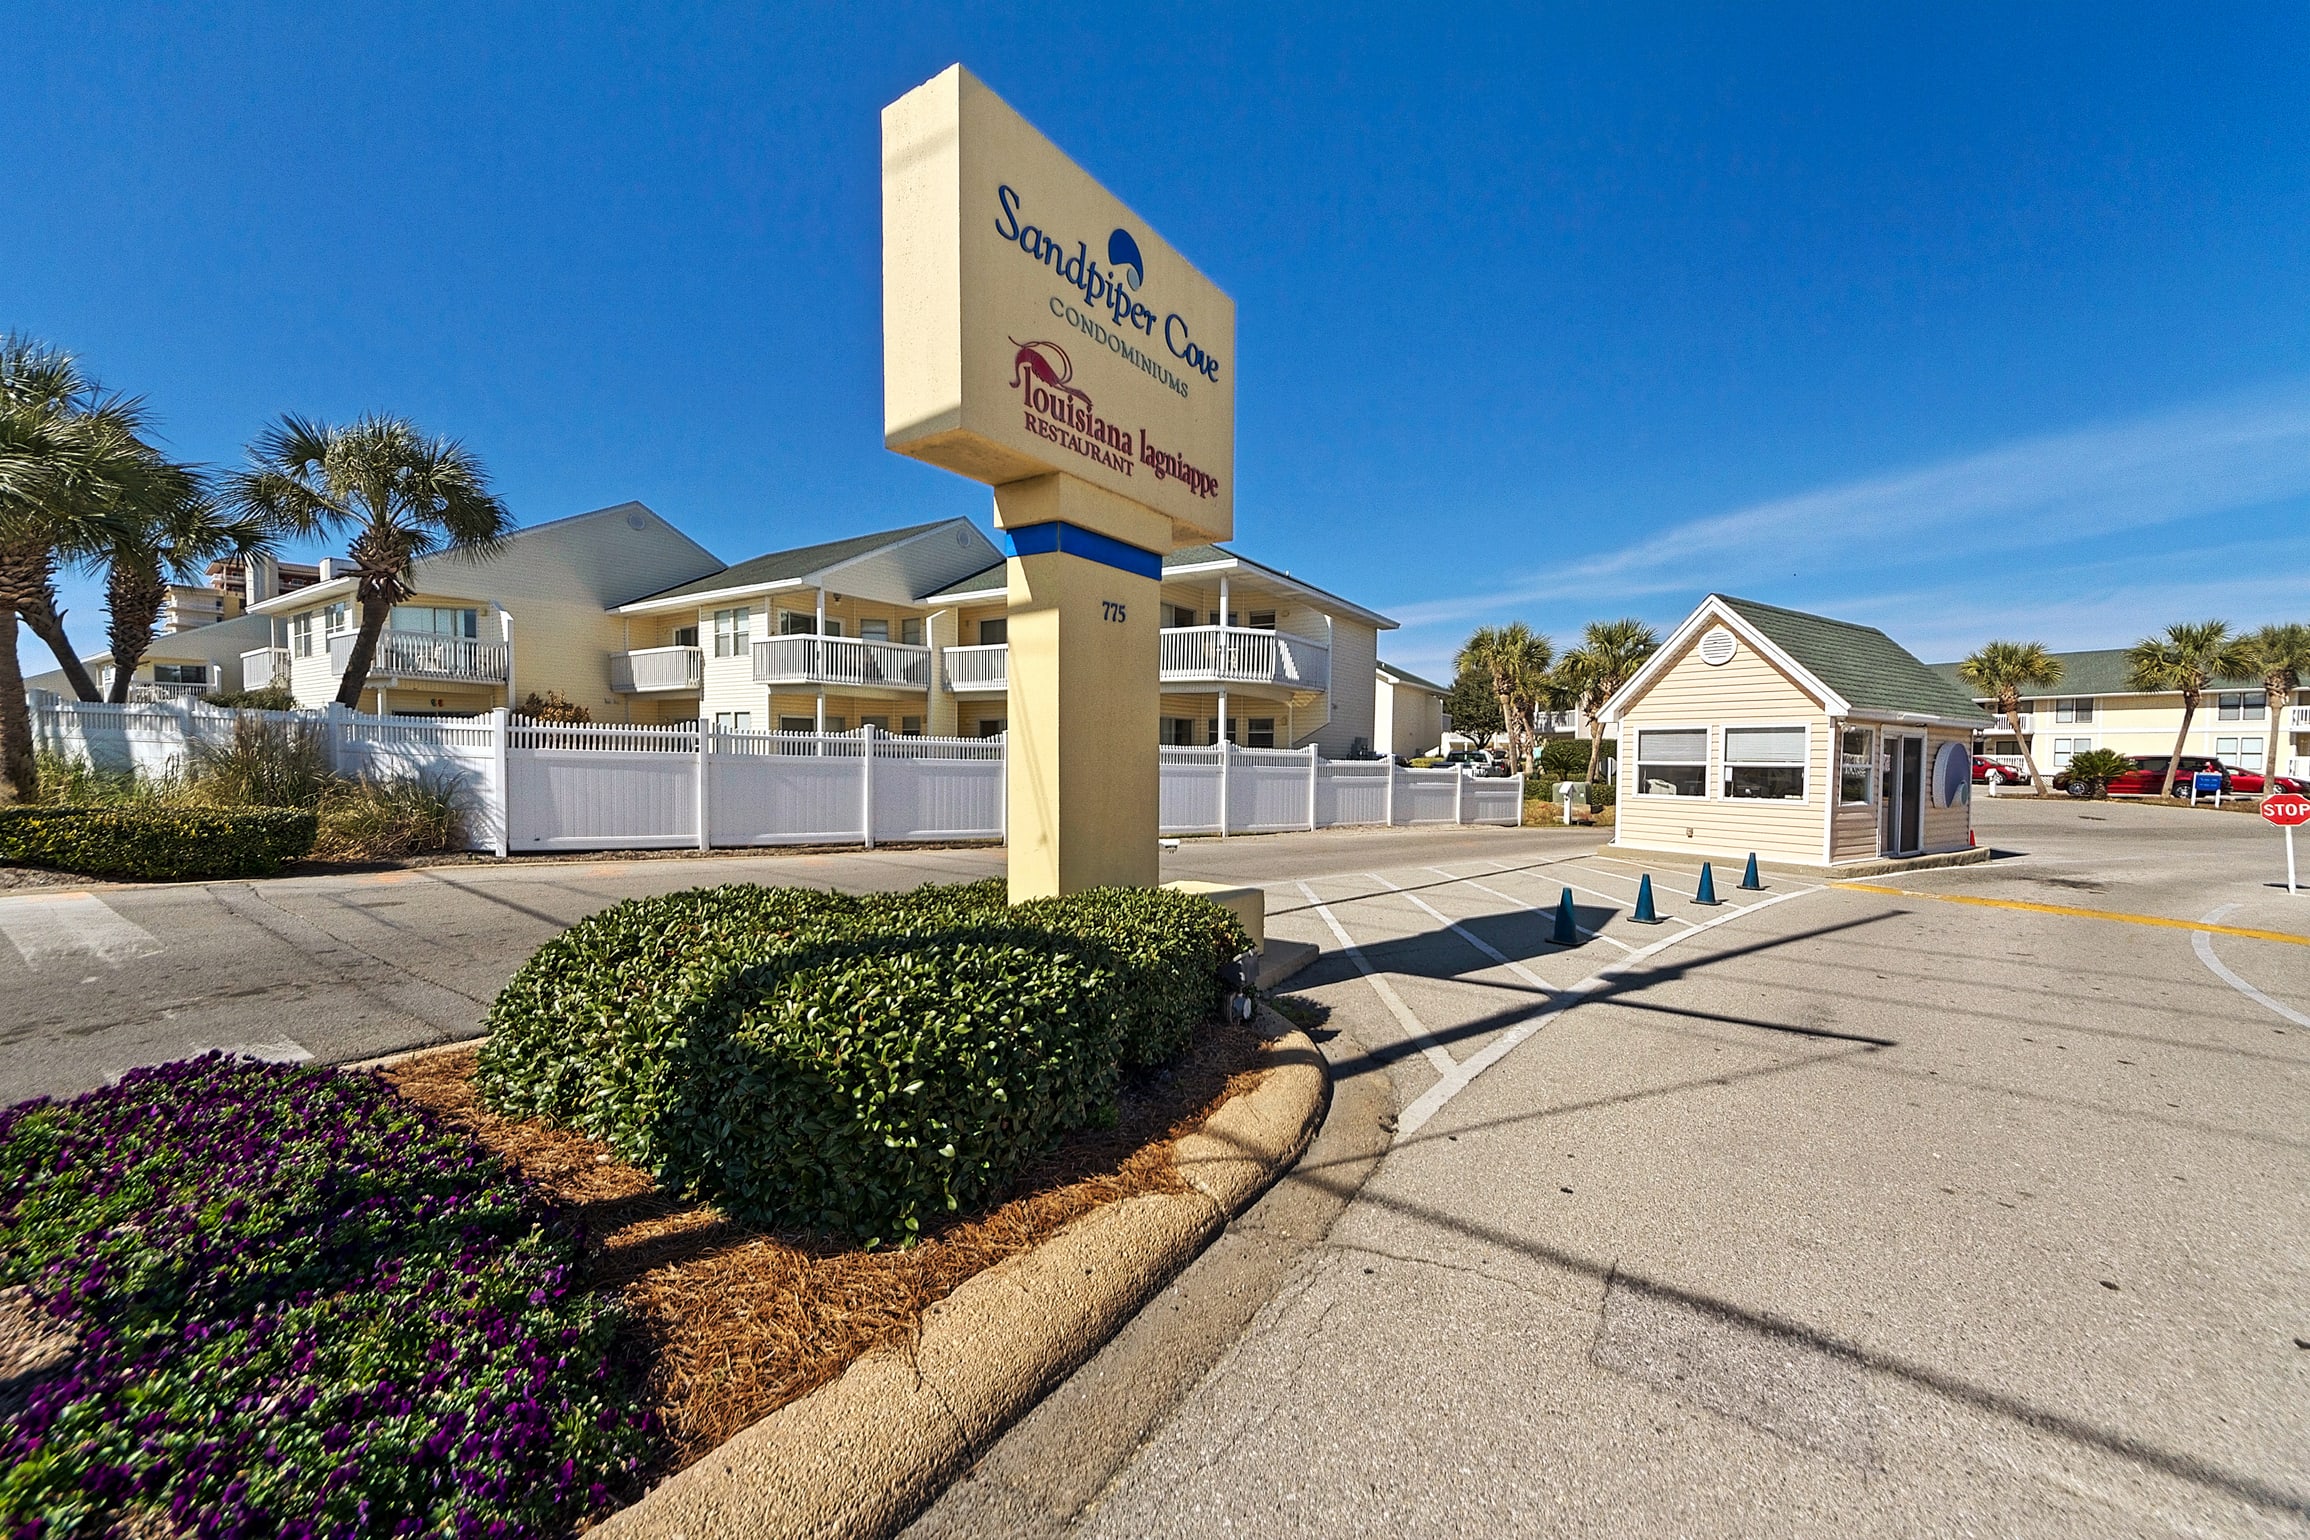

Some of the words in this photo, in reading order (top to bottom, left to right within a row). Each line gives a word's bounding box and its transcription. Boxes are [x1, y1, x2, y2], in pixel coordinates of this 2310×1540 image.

[995, 184, 1157, 336] Sandpiper
[1164, 313, 1219, 383] Cove
[1049, 296, 1189, 399] CONDOMINIUMS
[1023, 411, 1134, 477] RESTAURANT
[1102, 601, 1126, 623] 775
[2263, 803, 2310, 816] STOP
